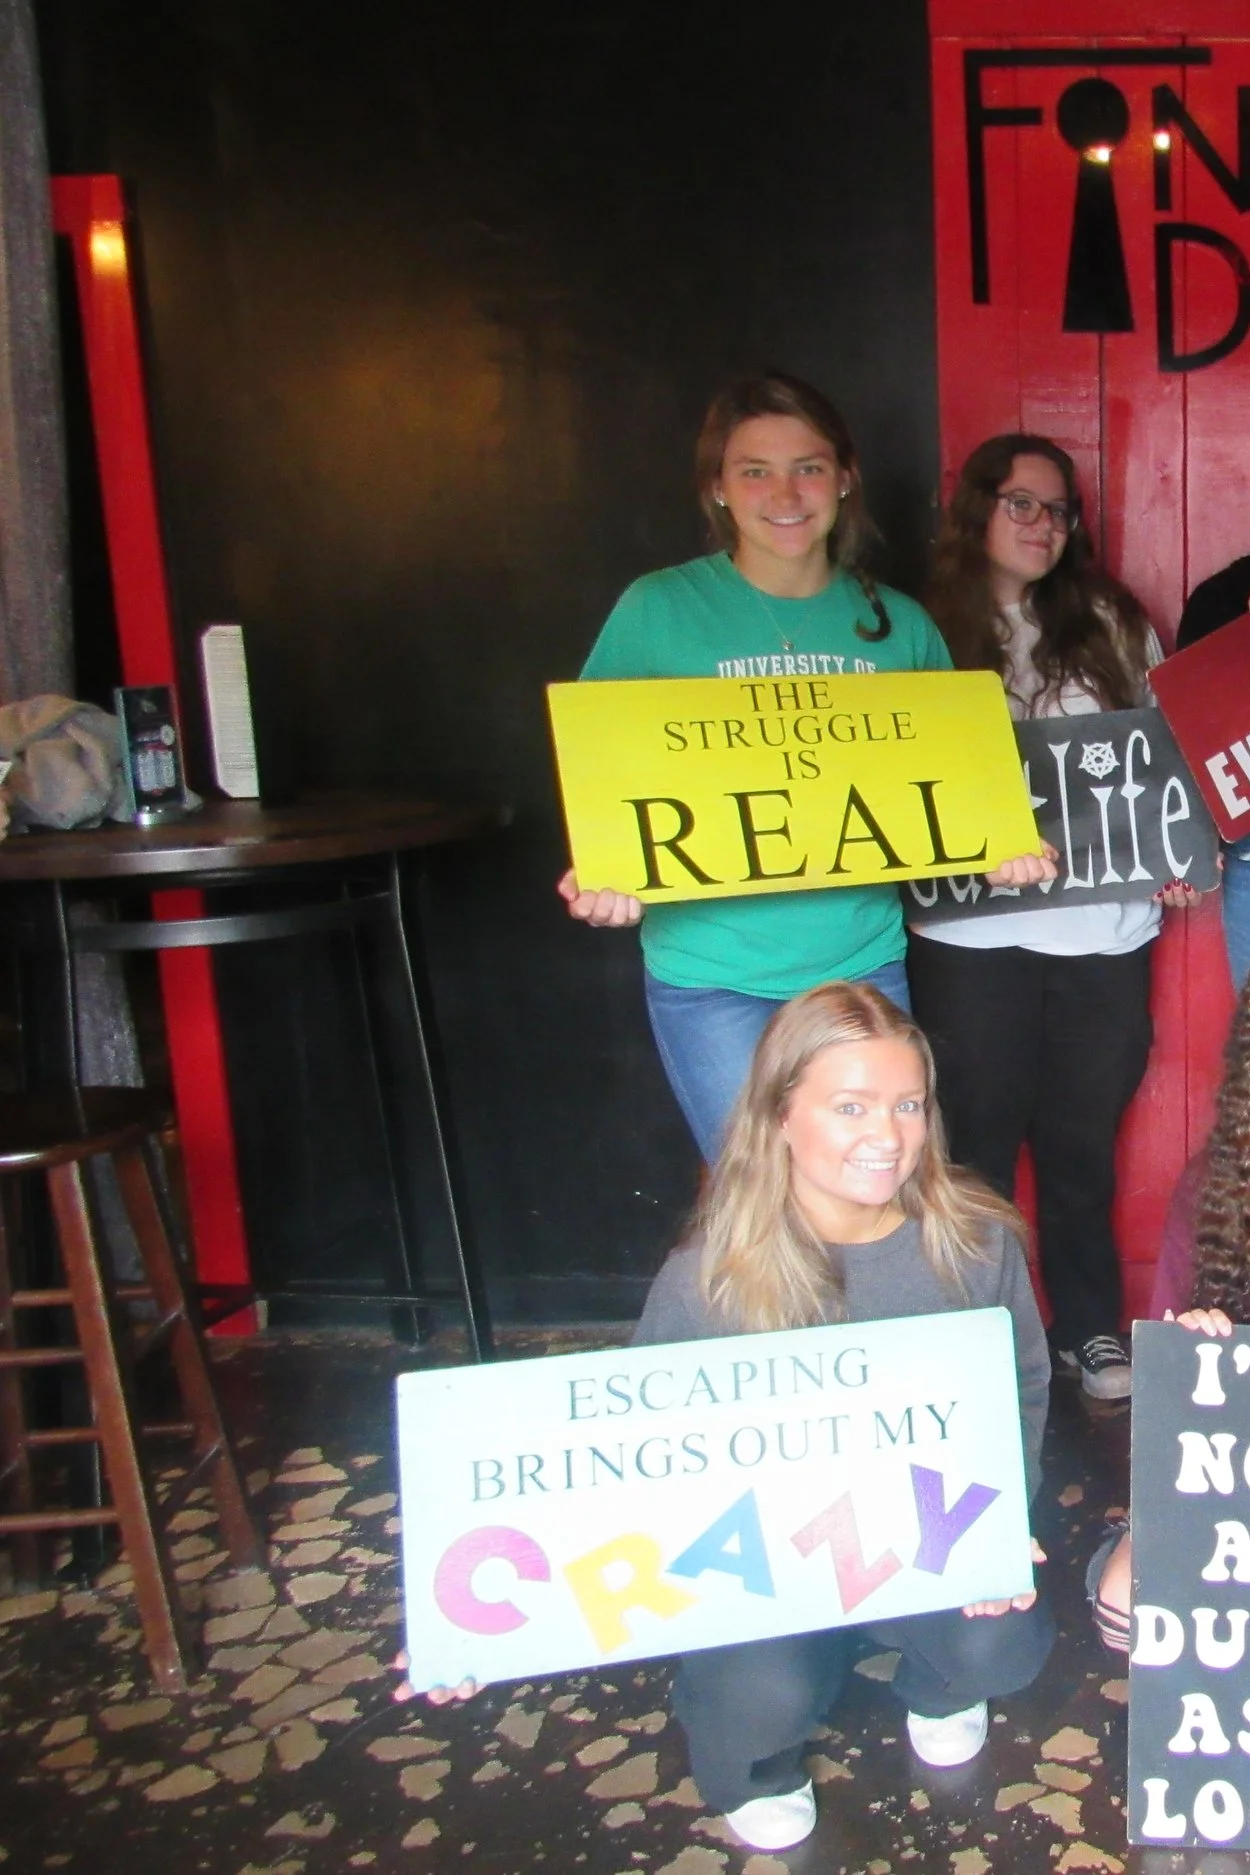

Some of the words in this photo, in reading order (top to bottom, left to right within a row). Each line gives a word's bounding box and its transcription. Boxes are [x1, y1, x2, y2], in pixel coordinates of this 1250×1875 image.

[717, 653, 846, 679] UNIVERSITY
[741, 680, 834, 714] THE
[664, 711, 918, 753] STRUGGLE
[782, 749, 822, 781] IS
[621, 779, 988, 892] REAL
[566, 1346, 871, 1422] ESCAPING
[468, 1430, 711, 1503] BRINGS
[727, 1412, 852, 1469] OUT
[872, 1399, 960, 1451] MY
[433, 1462, 1003, 1658] CRAZY
